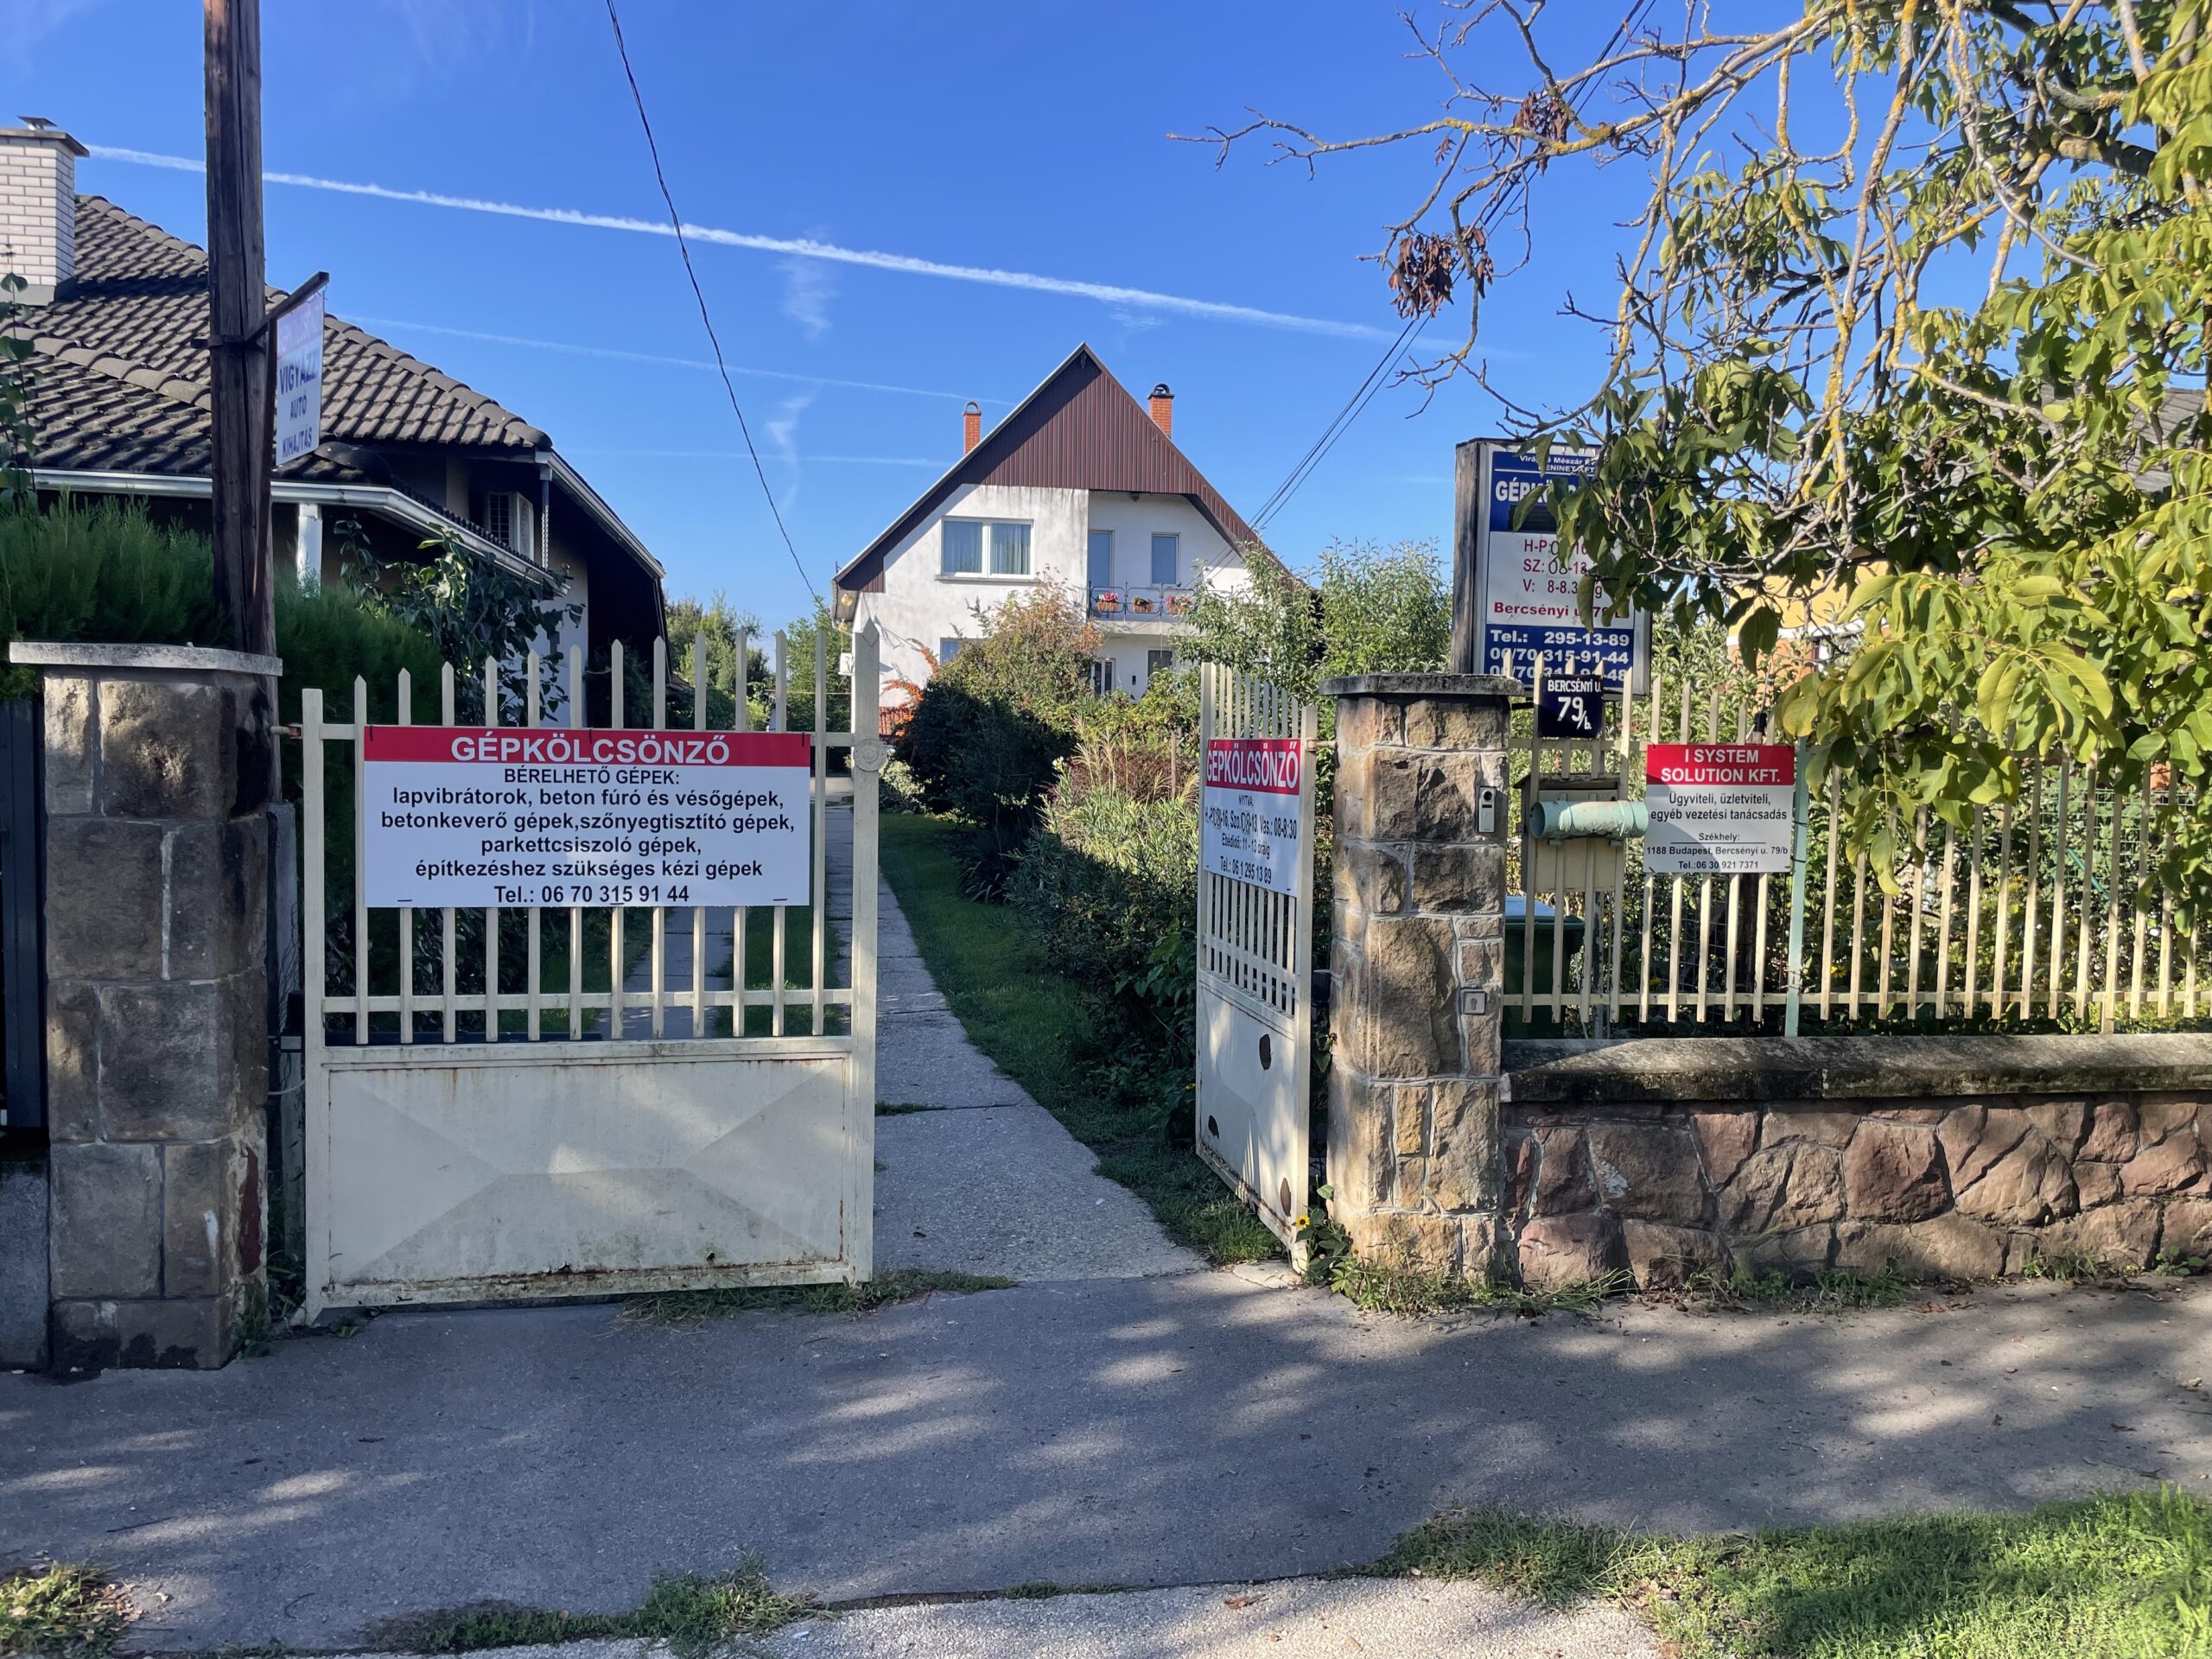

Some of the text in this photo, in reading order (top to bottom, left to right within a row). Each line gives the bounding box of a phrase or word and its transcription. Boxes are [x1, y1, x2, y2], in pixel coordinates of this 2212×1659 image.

[282, 423, 313, 458] KIHAJTÁS
[1523, 558, 1544, 573] SZ:
[1522, 578, 1535, 592] V:
[1494, 602, 1569, 619] Bercsényi
[1490, 630, 1630, 646] Tel.: 295-13-89
[450, 731, 731, 766] GÉPKÖLCSÖNZŐ
[1685, 748, 1759, 763] I SYSTEM
[1206, 741, 1299, 789] GÉPKÖLCSÖNZŐ
[504, 766, 680, 785] BÉRELHETŐ GÉPEK:
[1661, 767, 1781, 783] SOLUTION KFT.
[392, 787, 785, 810] lapvibrátorok, beton fúró és vésőgépek,
[1669, 791, 1771, 806] Ügyviteli, üzletviteli,
[381, 811, 507, 830] betonkeverő
[733, 813, 795, 833] gépek,
[1650, 808, 1787, 822] egyéb vezetési tanácsadás
[1274, 817, 1298, 841] 08-8:30
[1698, 832, 1740, 842] Székhely:
[480, 836, 702, 856] parkettcsiszoló gépek,
[1222, 832, 1243, 850] Ebédidő:
[1243, 837, 1249, 851] 11
[1251, 838, 1257, 854] 13
[1669, 846, 1713, 857] Budapest,
[1715, 846, 1758, 856] Bercsényi
[416, 860, 763, 880] építkezéshez szükséges kézi gépek
[1220, 855, 1272, 885] Tel.: 06 1 295 13 89
[1709, 861, 1719, 869] 30
[1721, 861, 1737, 869] 921
[1739, 861, 1758, 869] 7371
[494, 886, 690, 903] Tel.: 06 70 315 91 44
